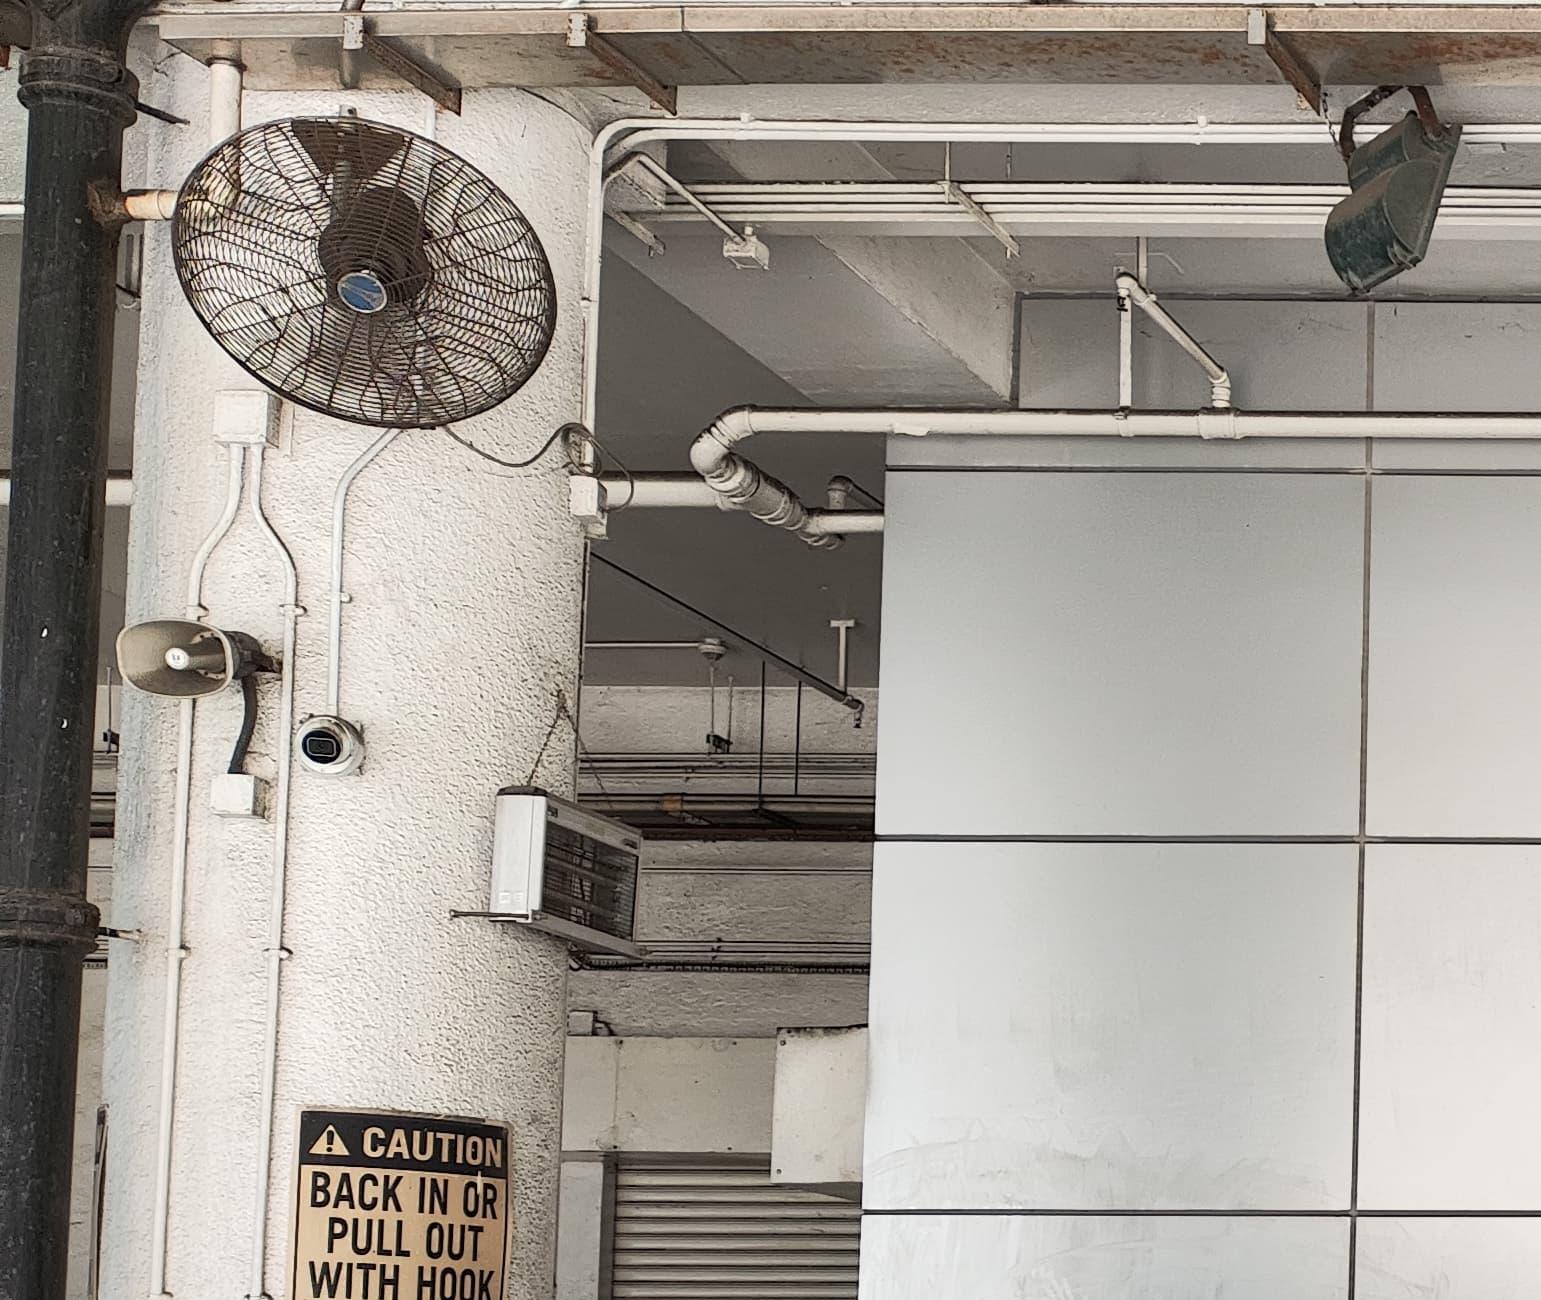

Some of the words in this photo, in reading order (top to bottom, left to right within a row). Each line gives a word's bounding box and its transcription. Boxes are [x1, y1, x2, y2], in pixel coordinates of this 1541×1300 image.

[362, 1126, 502, 1168] CAUTION
[310, 1171, 404, 1213] BACK
[418, 1176, 449, 1216] IN
[463, 1180, 498, 1220] OR
[327, 1216, 411, 1258] PULL
[425, 1221, 484, 1262] OUT
